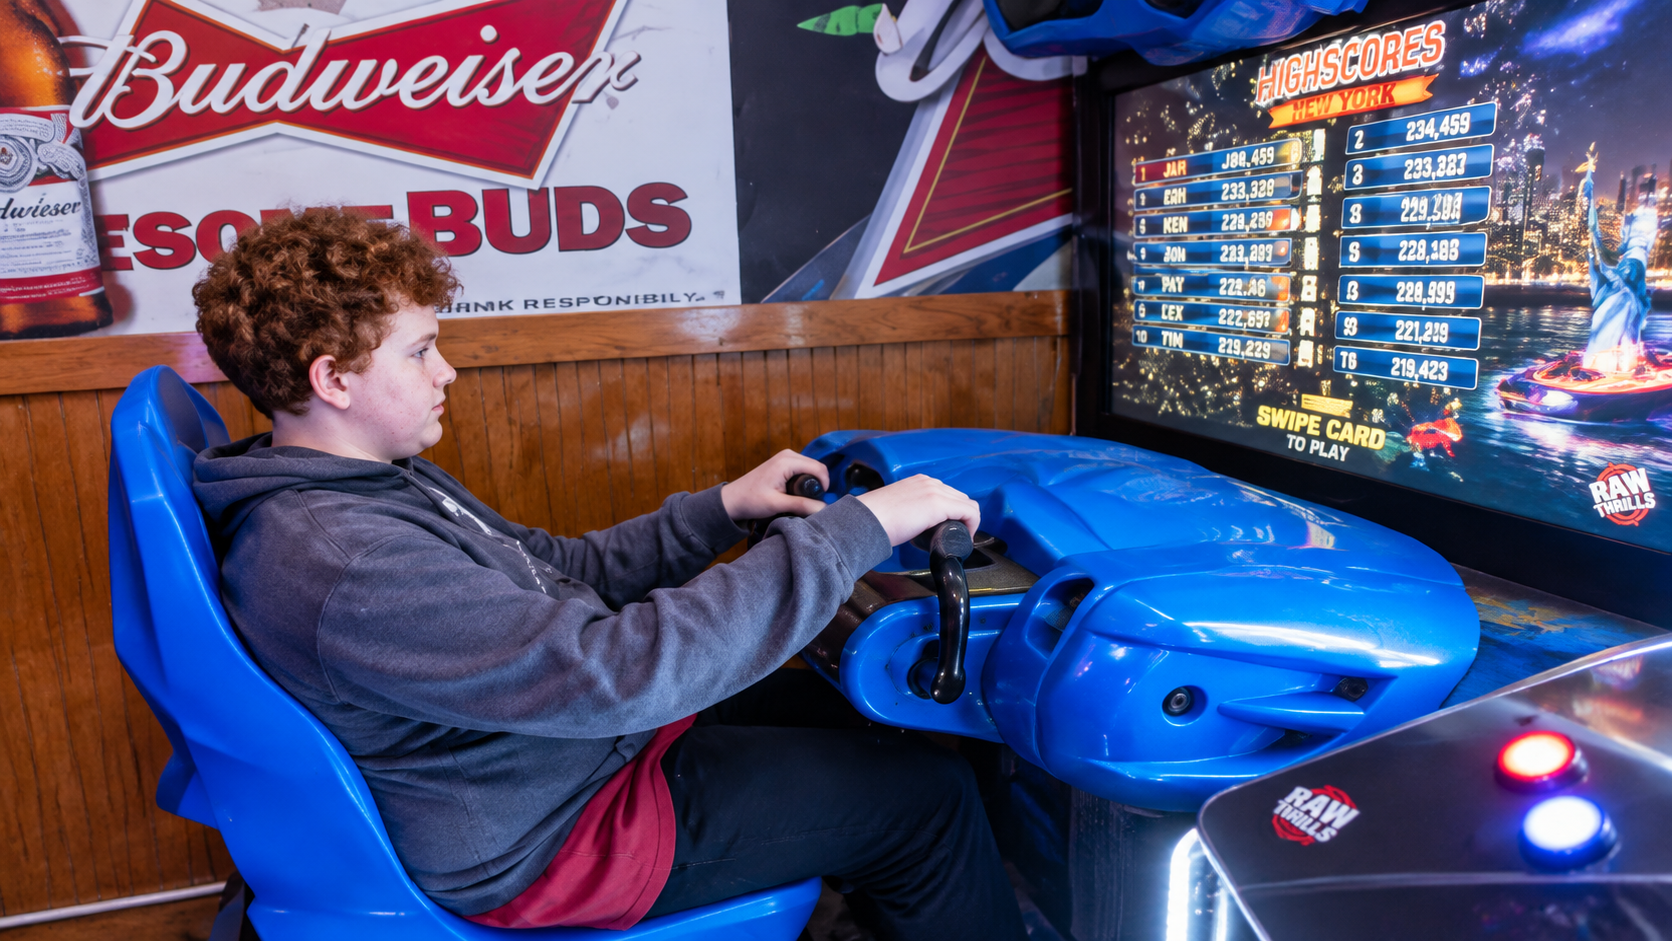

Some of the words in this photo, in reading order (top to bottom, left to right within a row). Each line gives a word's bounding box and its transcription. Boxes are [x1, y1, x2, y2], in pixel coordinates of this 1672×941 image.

[58, 24, 642, 131] Budweiser
[1256, 20, 1446, 107] HIGHSCORES
[1291, 93, 1333, 122] NEW
[1339, 82, 1397, 111] YORK
[1354, 129, 1364, 149] 2
[1406, 112, 1471, 142] 234,459
[1141, 166, 1147, 181] 1
[406, 182, 692, 257] BUDS
[1163, 215, 1188, 234] KEN
[1161, 276, 1185, 293] PAY
[1135, 329, 1148, 344] 10
[1161, 330, 1184, 348] TIN
[1391, 356, 1449, 382] 219,423
[1256, 404, 1322, 437] SWIPE
[1325, 418, 1386, 450] CARD
[1286, 433, 1307, 452] TO
[1309, 439, 1350, 462] PLAY
[1588, 467, 1652, 505] RAW
[1592, 492, 1657, 518] THRILLS
[1283, 785, 1361, 830] RAW
